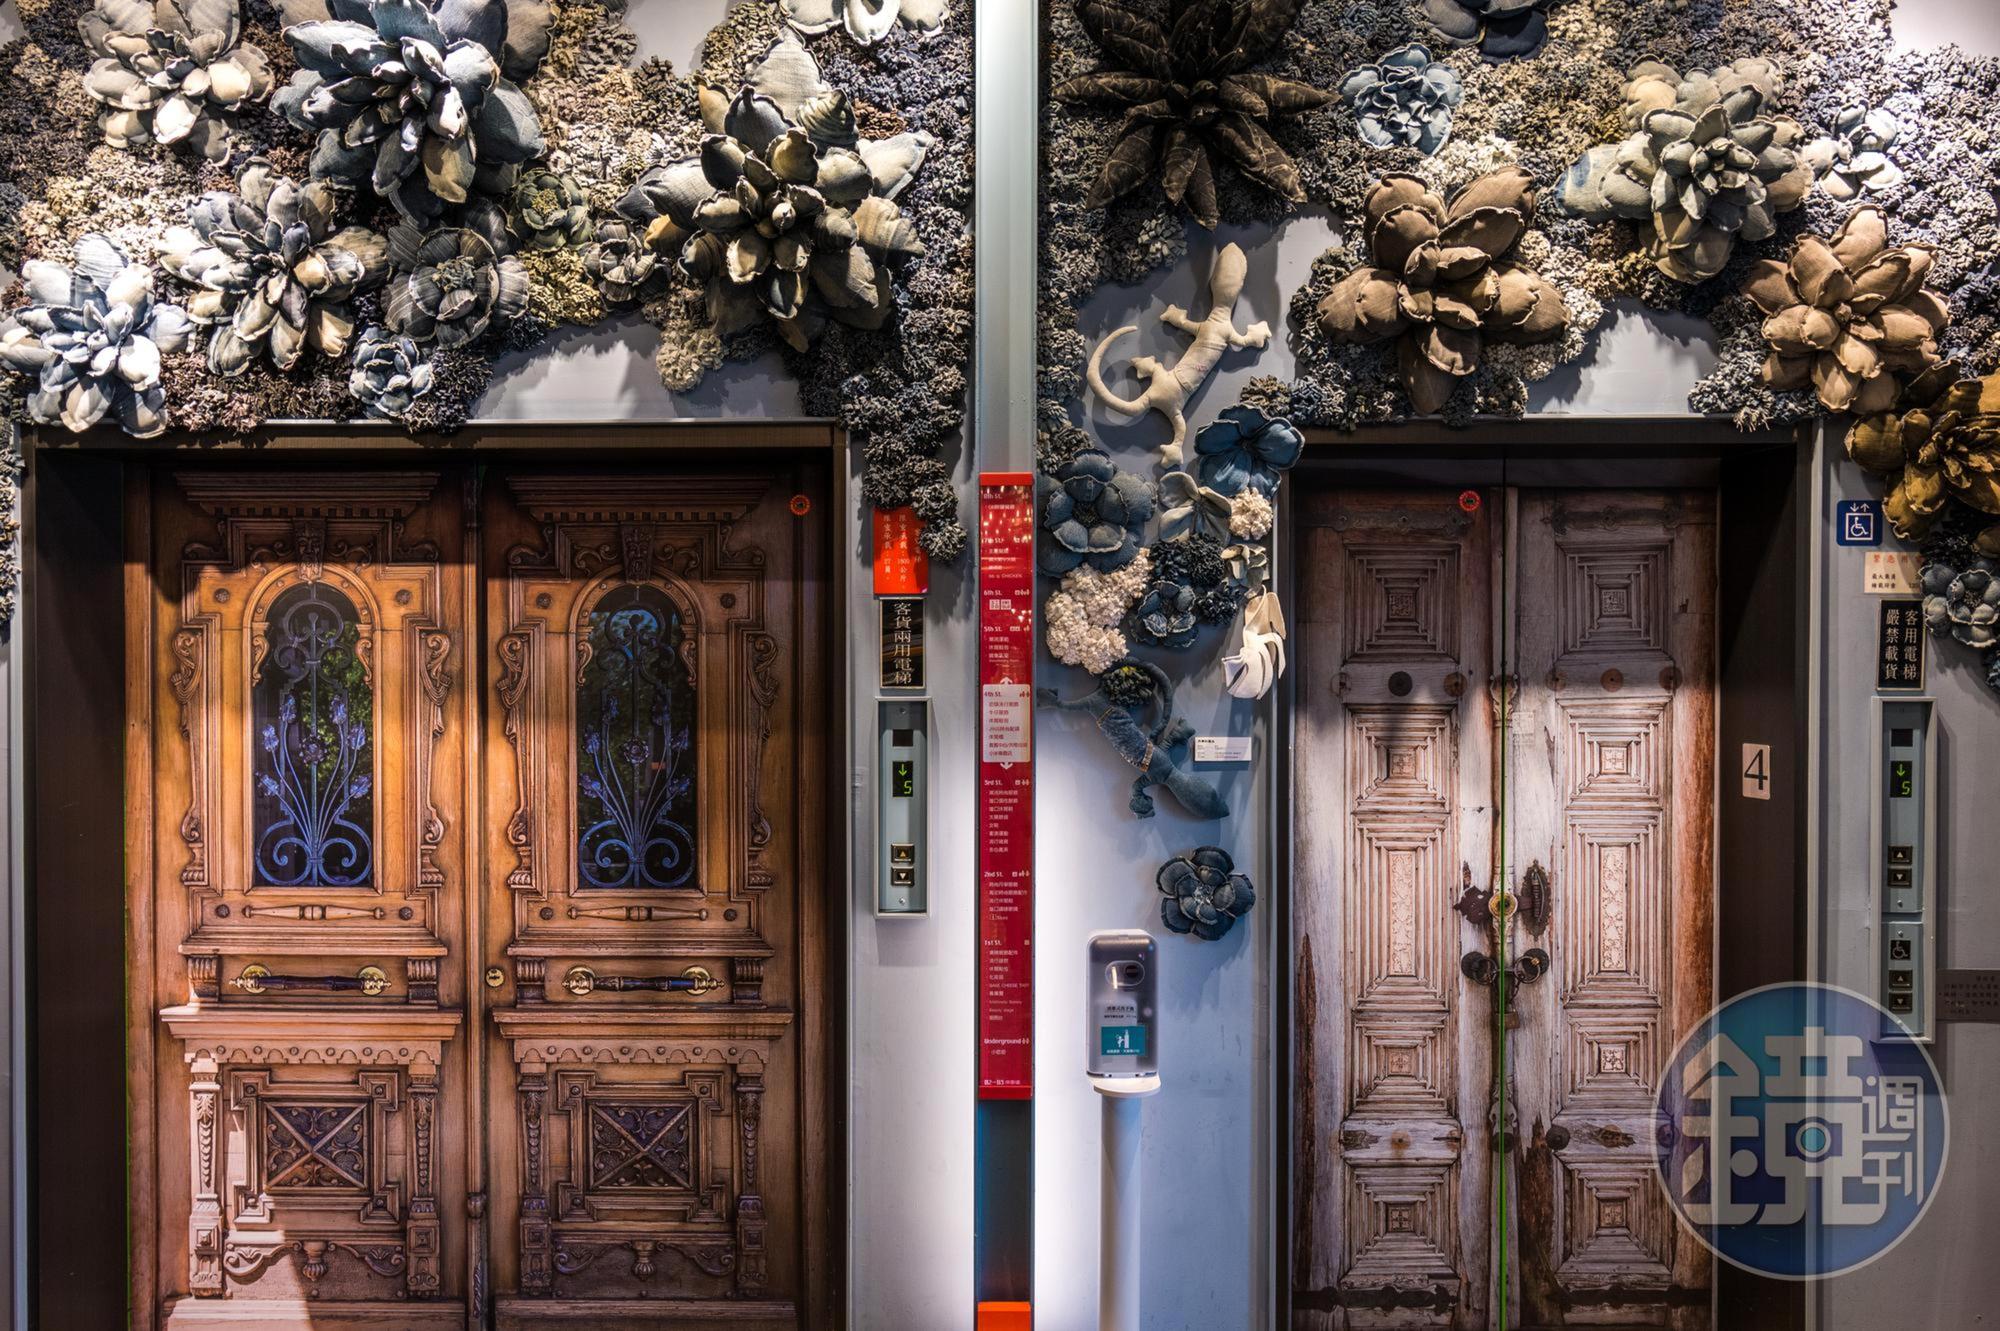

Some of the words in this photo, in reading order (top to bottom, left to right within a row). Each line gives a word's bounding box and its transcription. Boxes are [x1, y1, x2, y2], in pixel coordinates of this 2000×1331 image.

[894, 602, 913, 684] 客貨兩用電梯
[1885, 609, 1900, 680] 嚴禁載貨
[1903, 609, 1919, 680] 客用電梯
[904, 781, 912, 794] 5
[1744, 749, 1768, 790] 4
[1901, 781, 1911, 795] 5
[984, 1038, 1021, 1046] Underground
